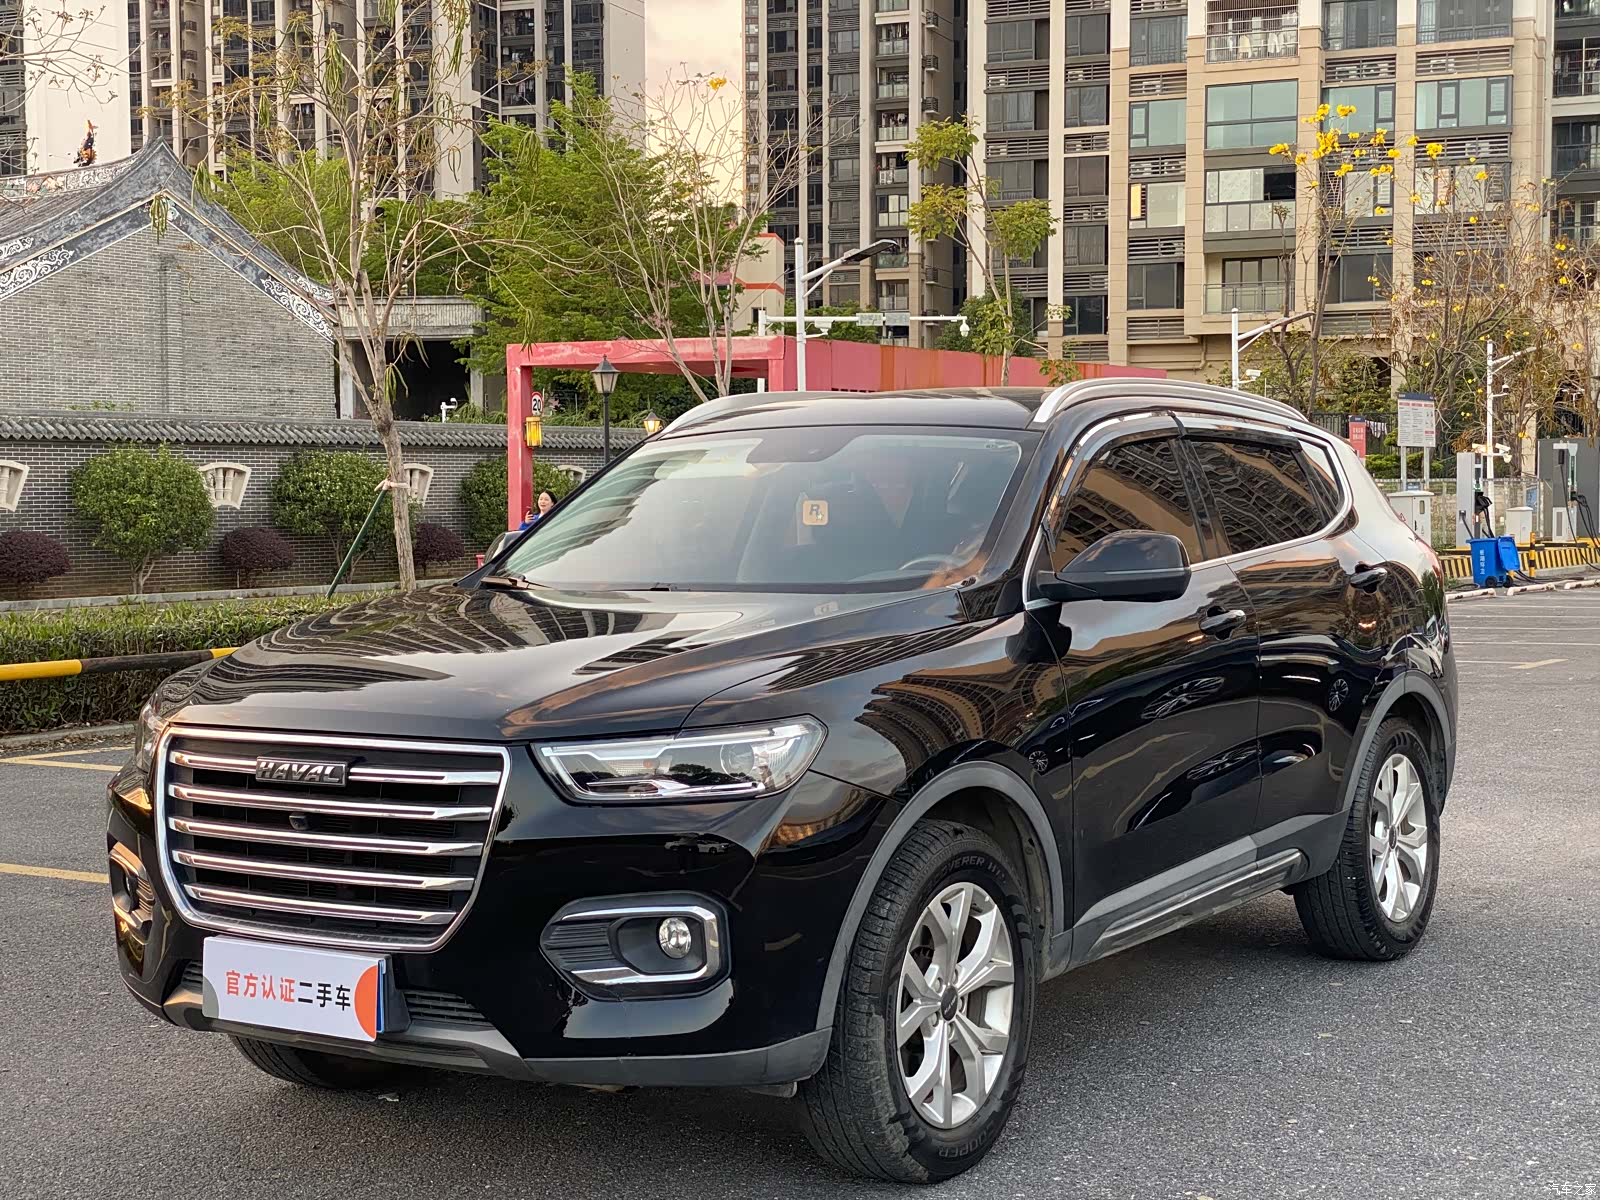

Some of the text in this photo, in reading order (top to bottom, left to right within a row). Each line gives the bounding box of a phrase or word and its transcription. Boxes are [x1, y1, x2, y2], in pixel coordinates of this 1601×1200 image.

[533, 398, 542, 411] 20
[258, 761, 340, 782] HAVAL
[225, 969, 351, 1011] 官方认证二手车
